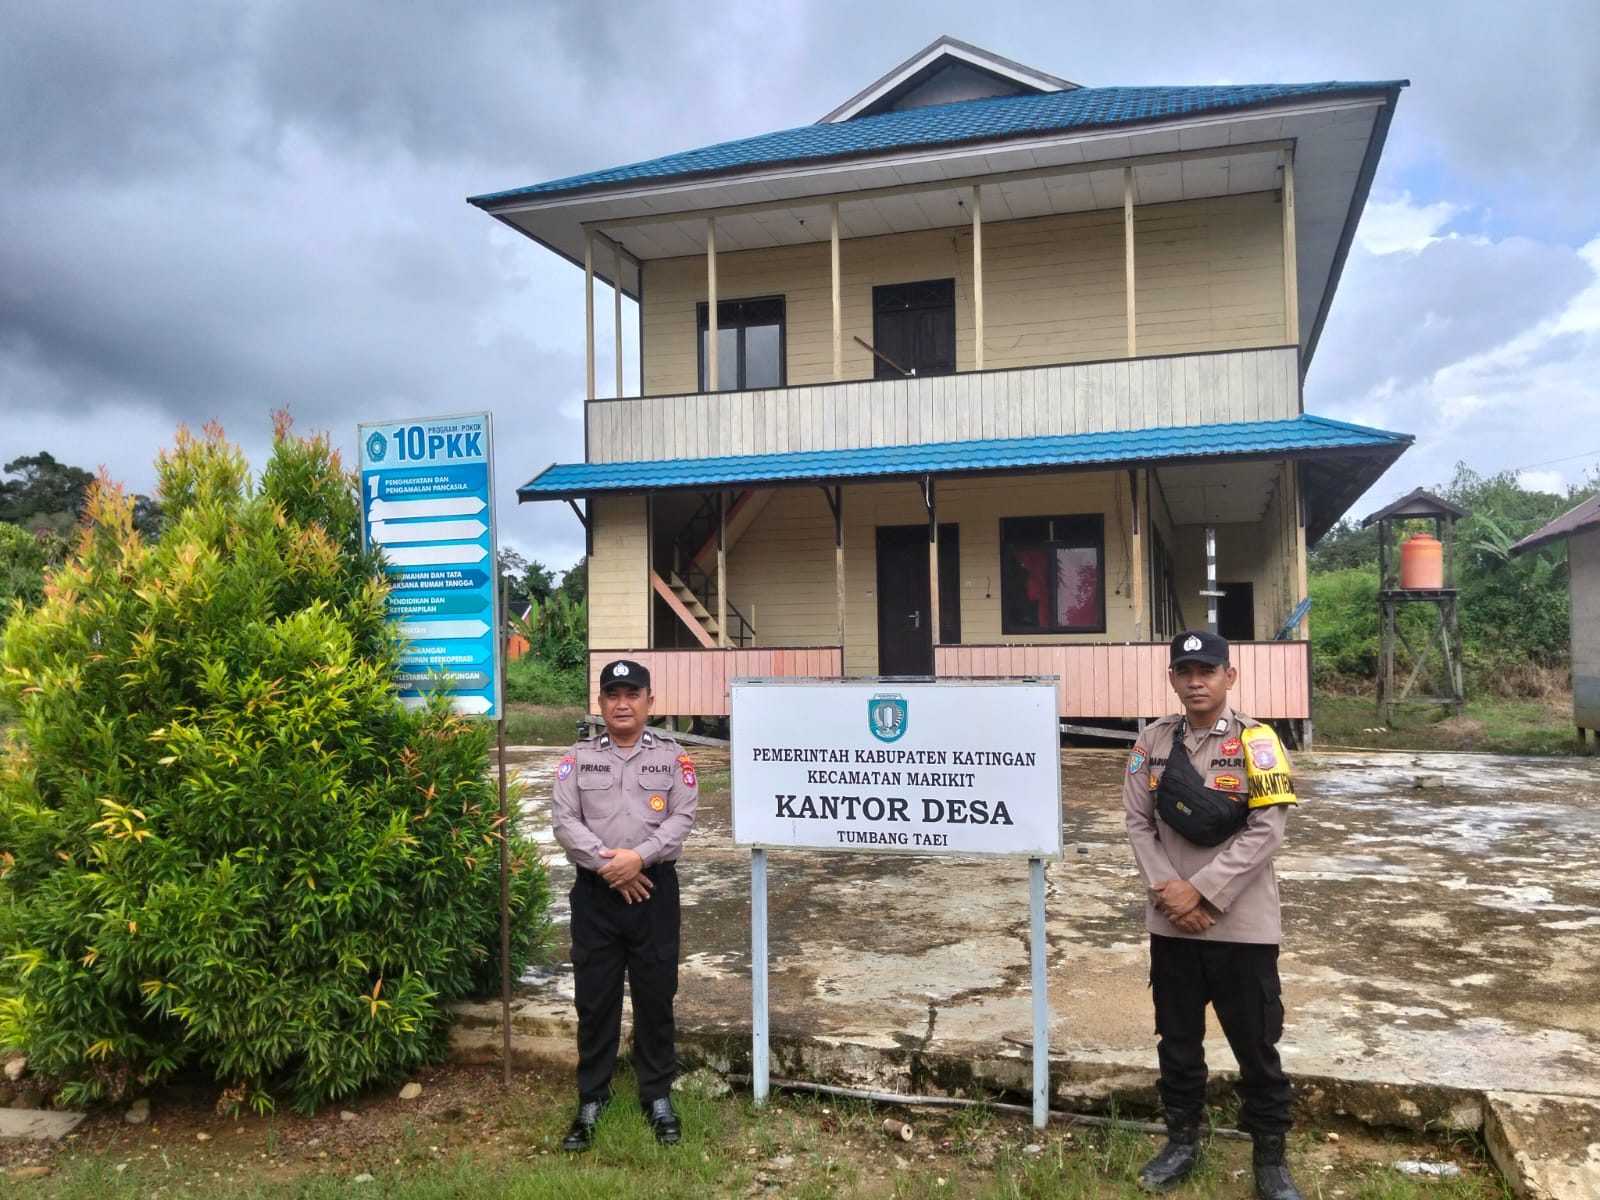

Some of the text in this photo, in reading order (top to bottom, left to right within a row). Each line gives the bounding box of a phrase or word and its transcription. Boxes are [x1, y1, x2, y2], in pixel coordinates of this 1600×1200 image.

[428, 423, 482, 434] PROGRAM POKOK
[393, 425, 482, 461] 10 PKK
[385, 477, 433, 486] PENGHAYATAN
[385, 483, 468, 494] PENGAMALAN PANCASILA
[430, 571, 445, 579] DAN
[446, 570, 462, 578] TATA
[392, 579, 474, 589] AKSANA RUMAH TANGGA
[429, 655, 473, 663] BERKOPERASI
[752, 748, 1036, 767] PEMERINTAH KABUPATEN KATINGAN
[1210, 758, 1246, 768] POLRI
[580, 764, 612, 773] PRIADIE
[641, 765, 671, 774] POLRI
[807, 770, 976, 787] KECAMATAN MARIKIT
[775, 794, 1014, 825] KANTOR DESA
[837, 830, 948, 846] TUMBANG TAEI
